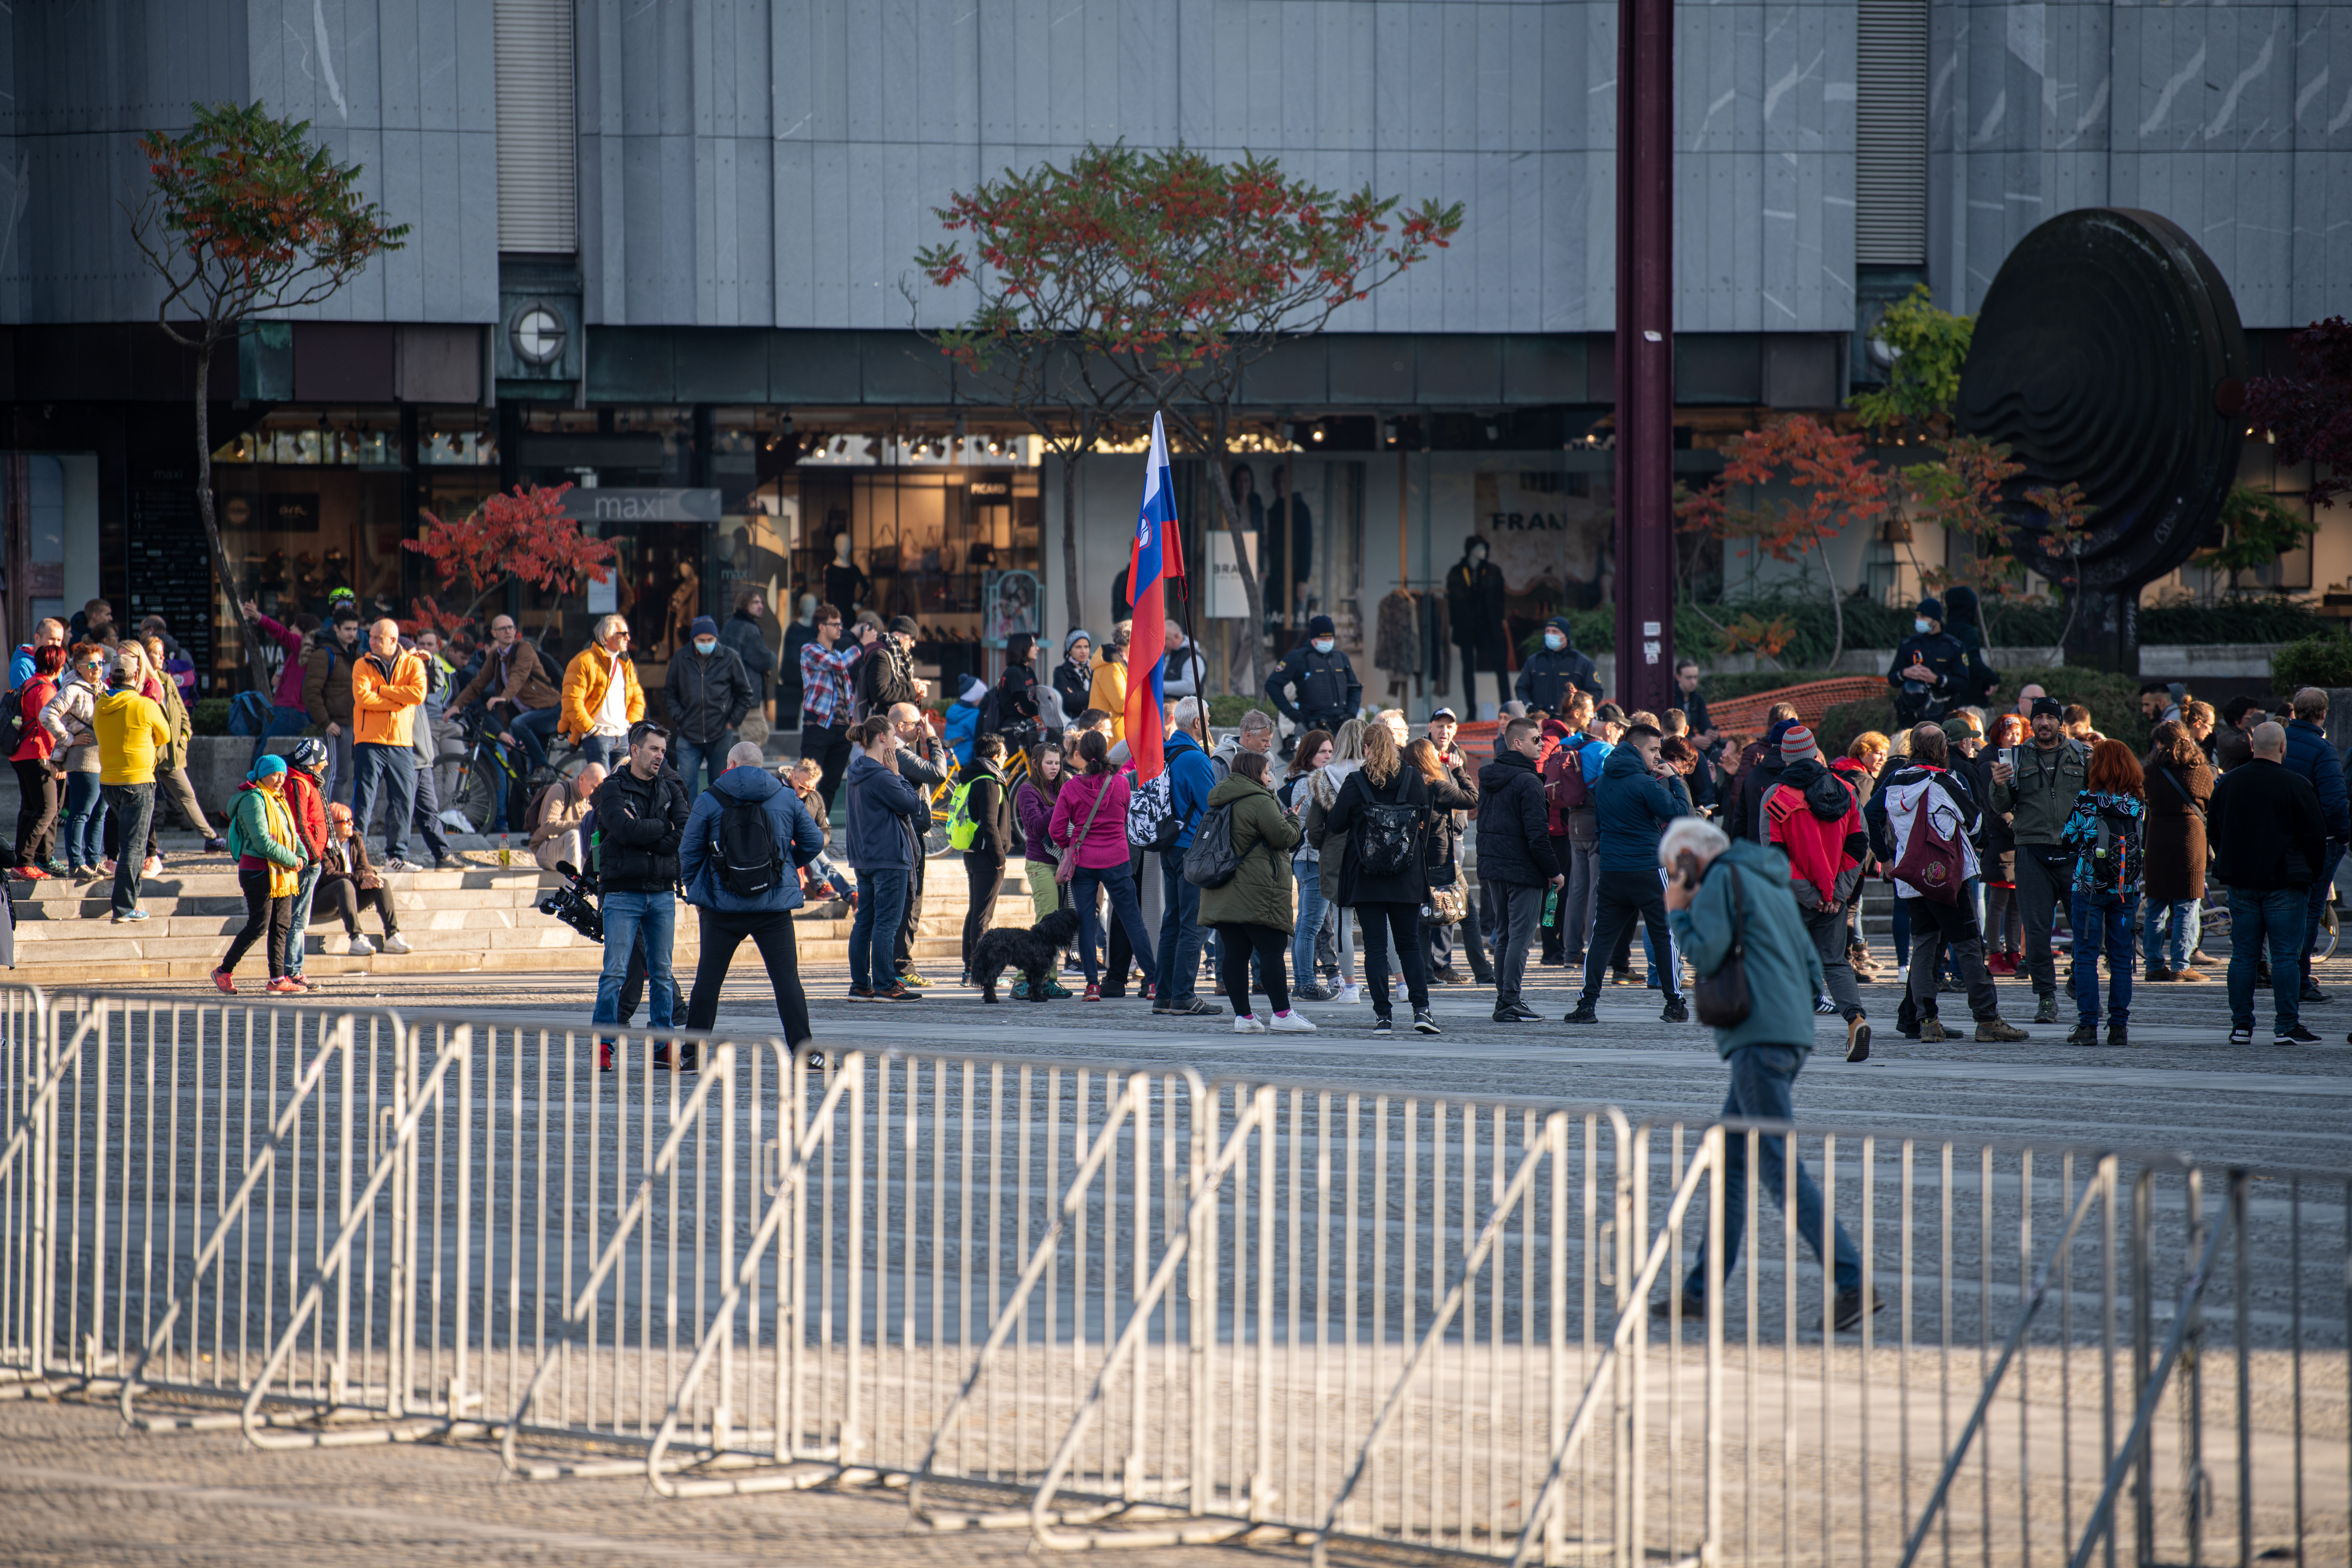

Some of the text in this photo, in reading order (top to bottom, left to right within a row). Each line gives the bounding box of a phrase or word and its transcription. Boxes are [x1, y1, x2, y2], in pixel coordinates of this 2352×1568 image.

[153, 468, 183, 480] maxi
[595, 493, 664, 519] maxi
[721, 568, 752, 580] maxi
[1214, 564, 1239, 573] BRA
